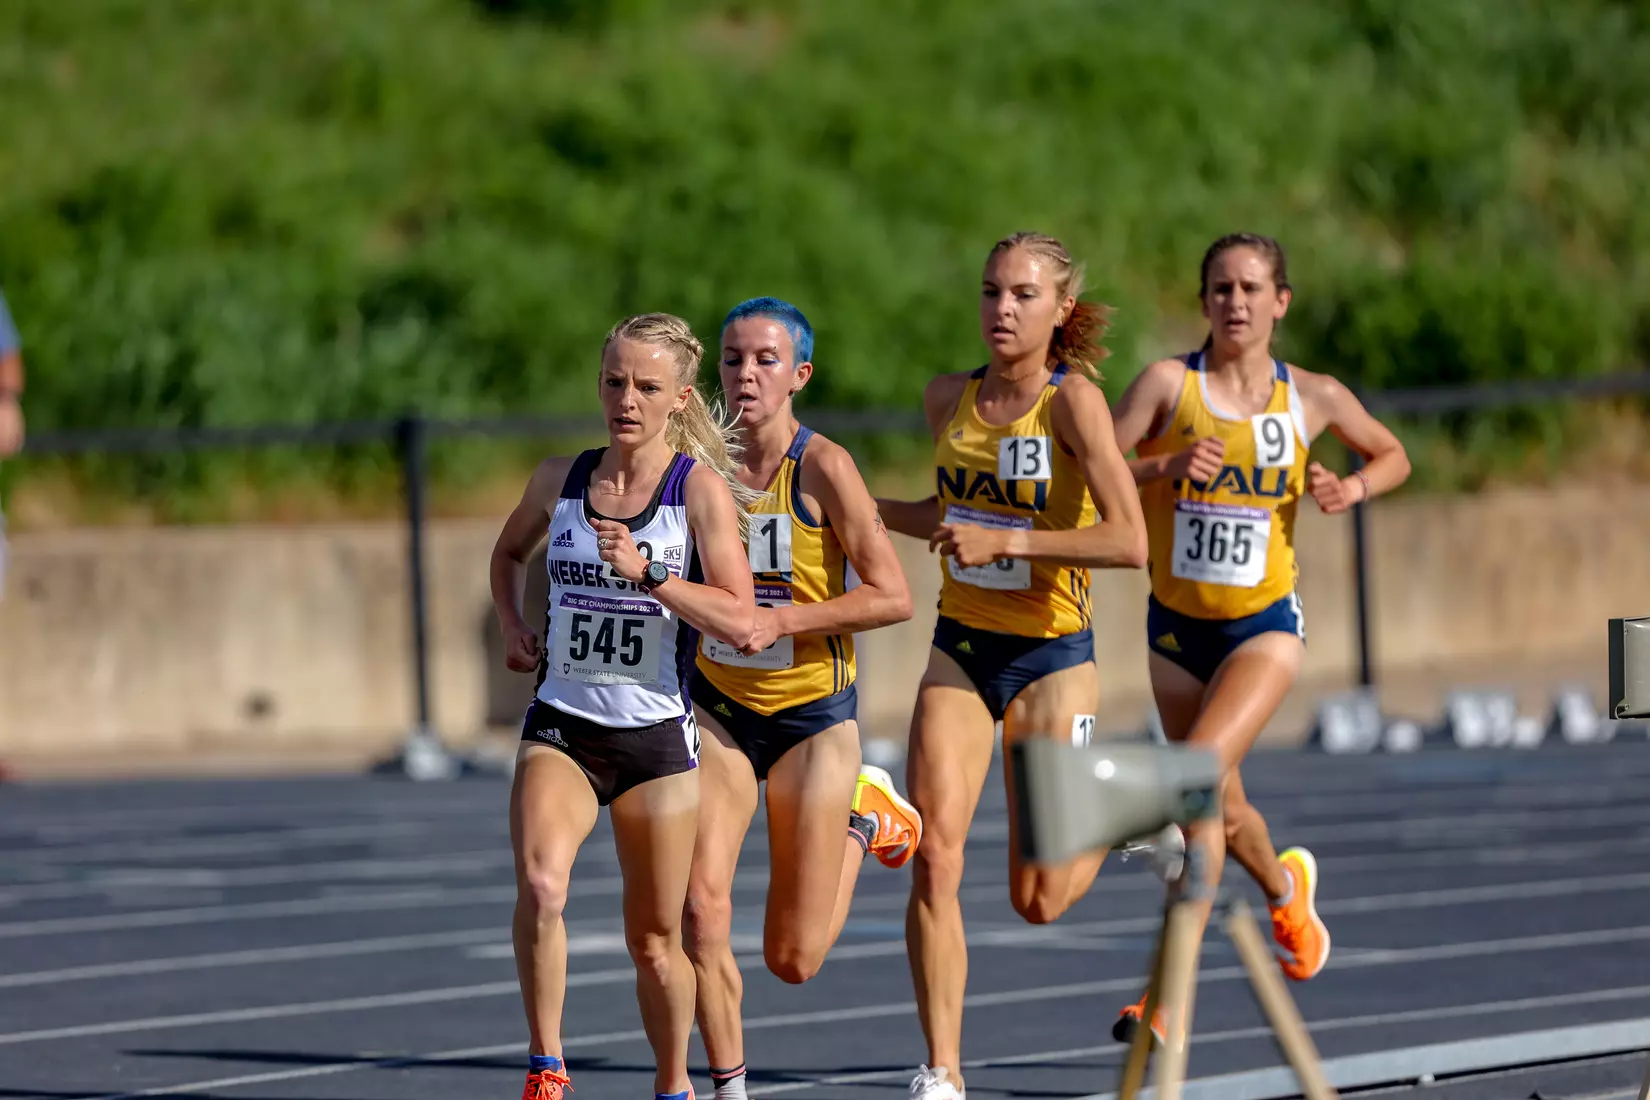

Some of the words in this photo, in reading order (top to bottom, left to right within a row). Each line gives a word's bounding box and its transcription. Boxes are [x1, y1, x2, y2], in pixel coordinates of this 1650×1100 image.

[1007, 439, 1042, 476] 13
[1262, 417, 1286, 464] 9
[937, 466, 1048, 512] NAU
[552, 539, 575, 548] adidas
[663, 548, 681, 561] SKY
[760, 518, 778, 569] 1
[1186, 518, 1254, 565] 365
[567, 597, 578, 605] BIG
[588, 600, 638, 611] CHAMPIONSHIPS
[569, 612, 645, 667] 545
[573, 666, 592, 675] WEBER
[593, 669, 610, 677] STATE
[612, 671, 648, 679] UNIVERSITY
[536, 729, 569, 748] adidas
